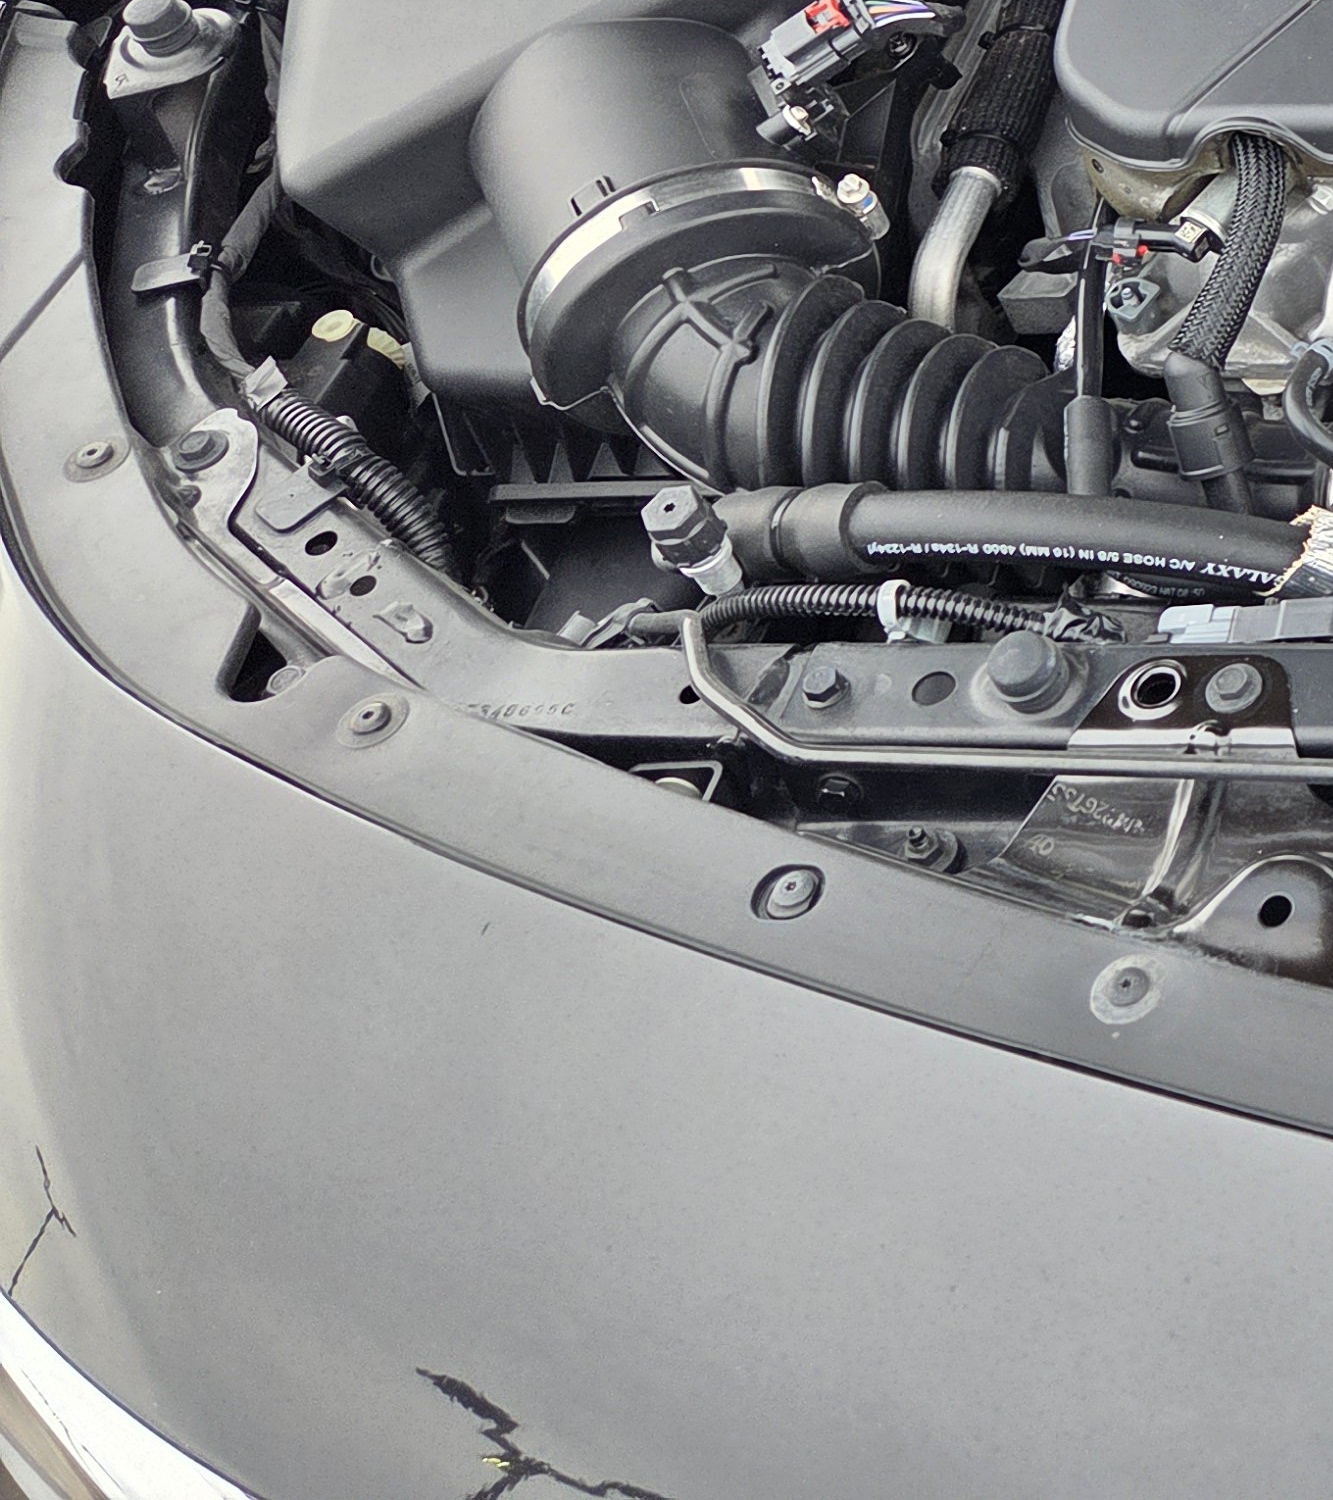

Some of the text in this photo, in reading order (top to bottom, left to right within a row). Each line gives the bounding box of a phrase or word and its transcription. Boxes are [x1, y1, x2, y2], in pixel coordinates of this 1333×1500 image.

[1019, 543, 1051, 557] MM)
[1078, 549, 1094, 561] IN
[1122, 552, 1166, 568] HOSE
[1169, 559, 1196, 572] A/C
